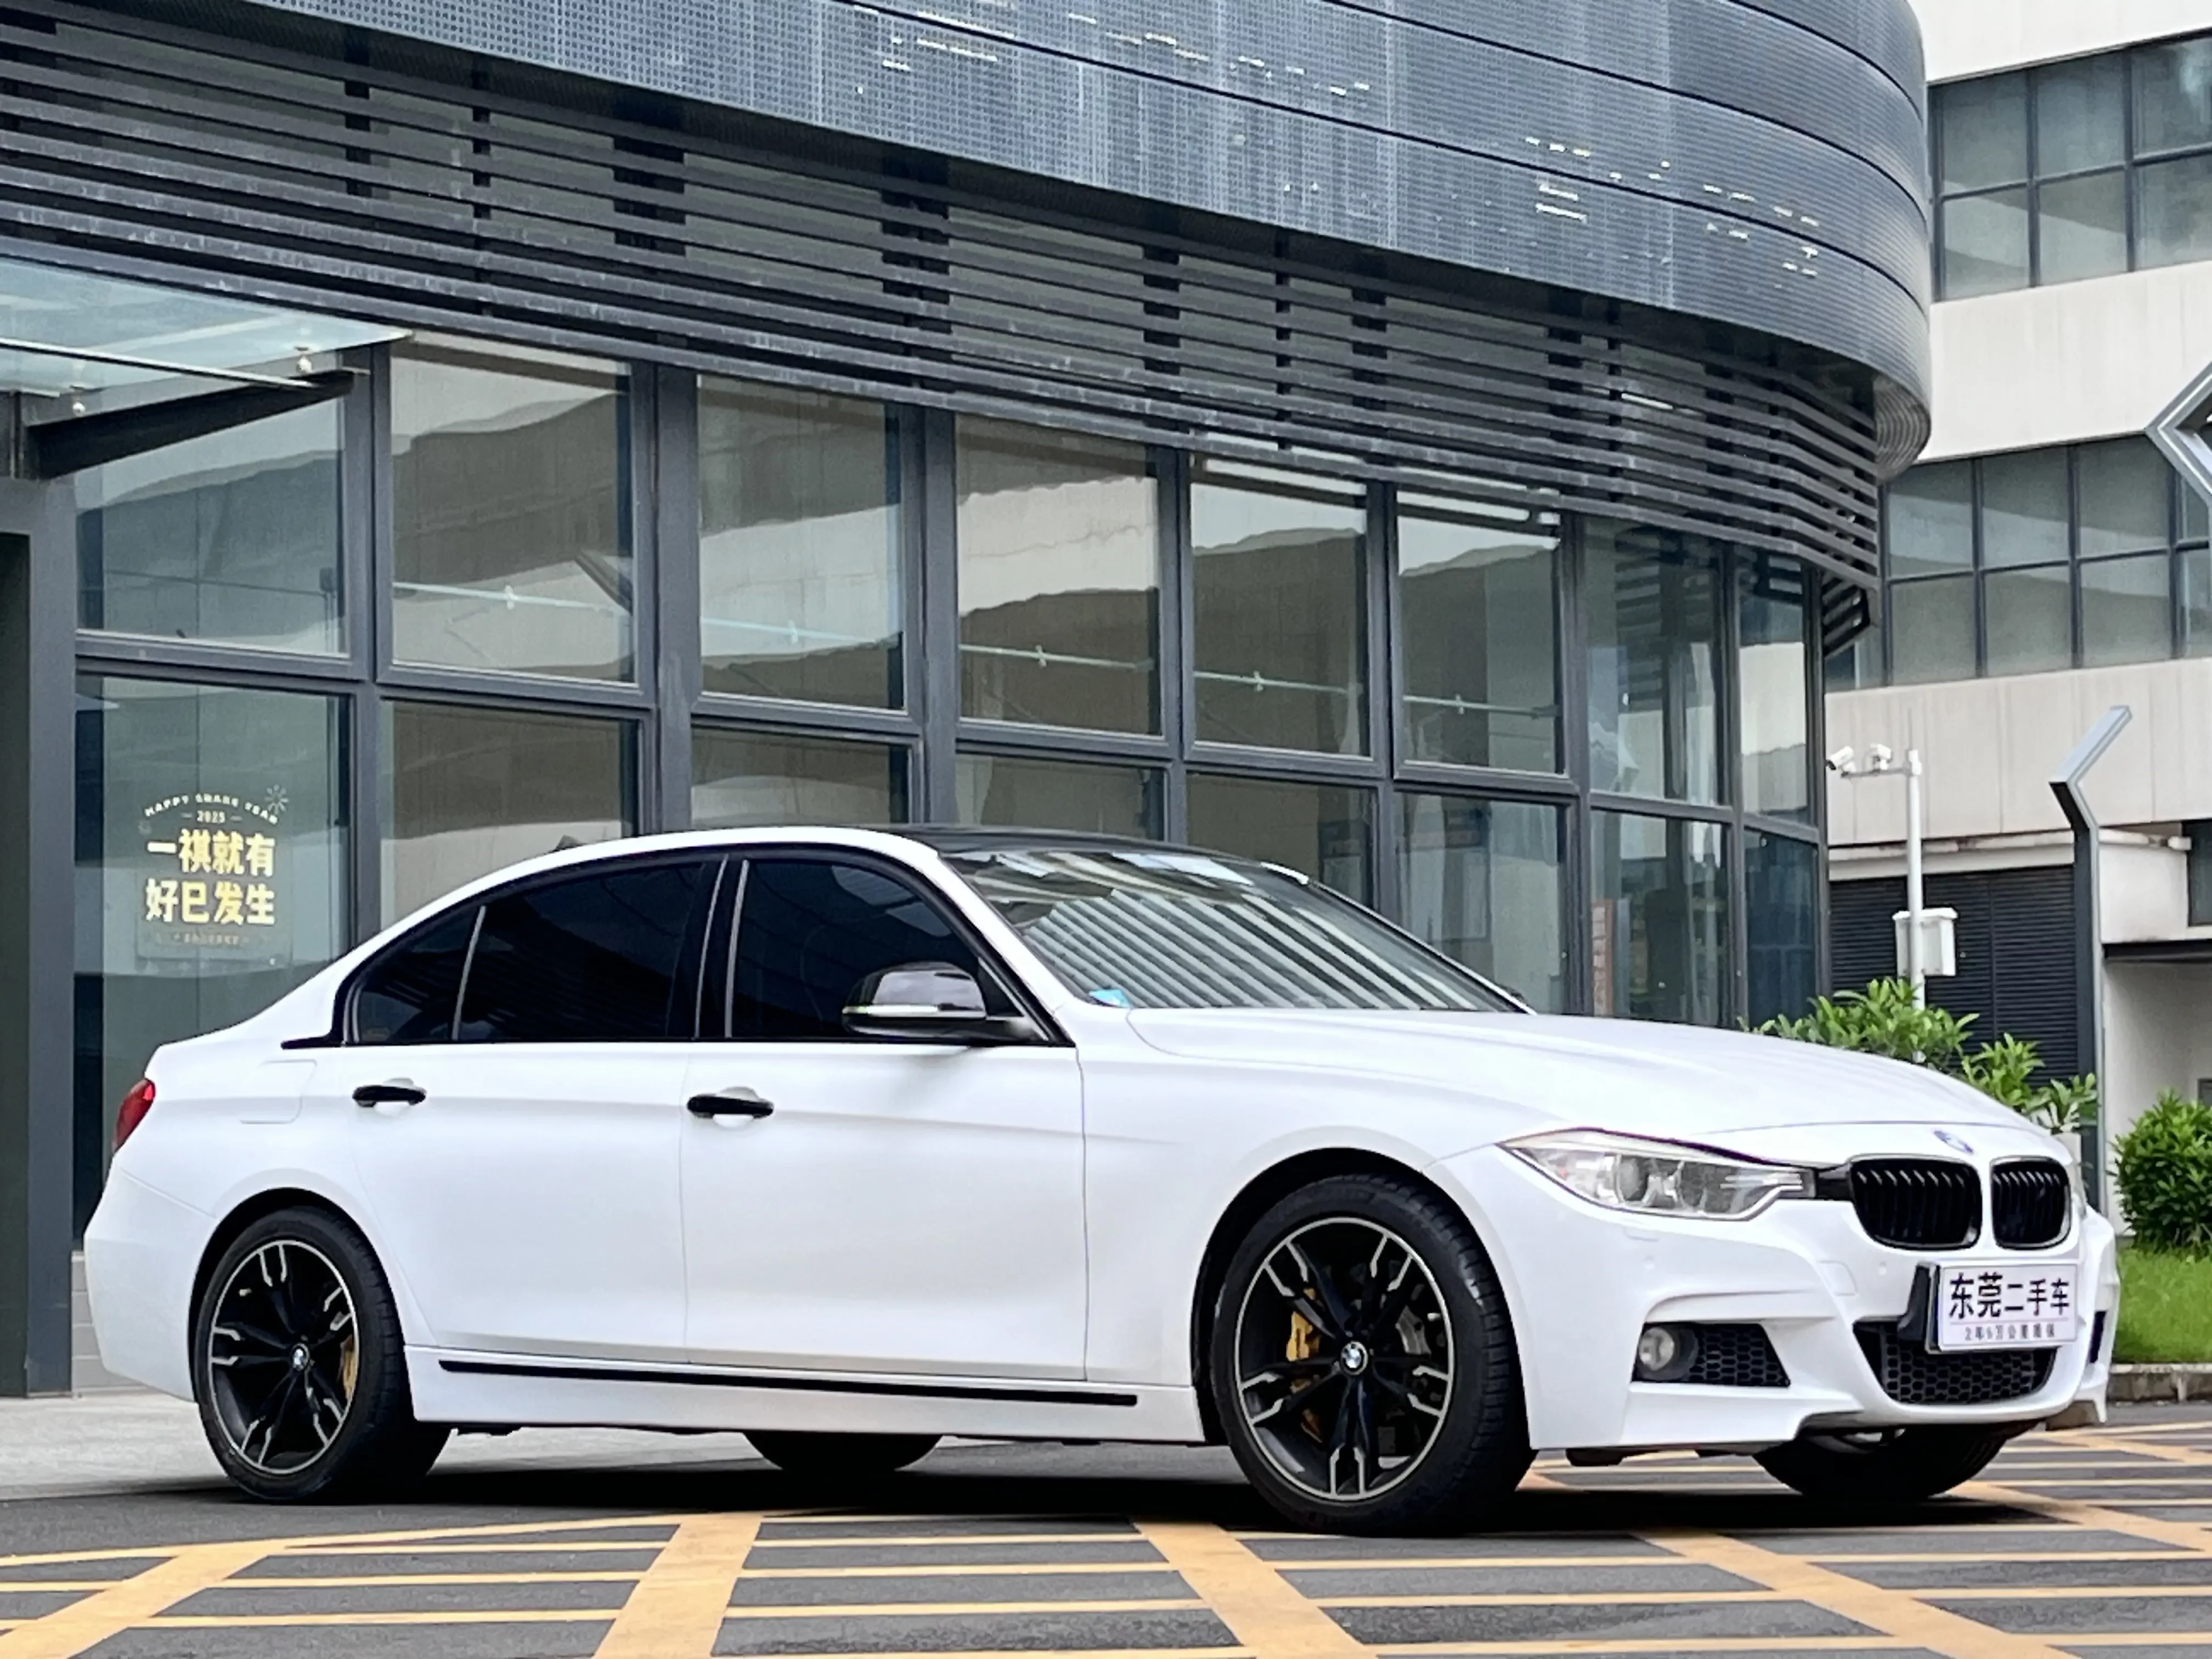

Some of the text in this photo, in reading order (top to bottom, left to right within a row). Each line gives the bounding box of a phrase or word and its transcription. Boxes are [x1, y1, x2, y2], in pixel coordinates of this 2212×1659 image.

[144, 794, 189, 817] HAPPY
[196, 810, 226, 823] 2025
[1949, 1271, 2070, 1319] 东莞二手车
